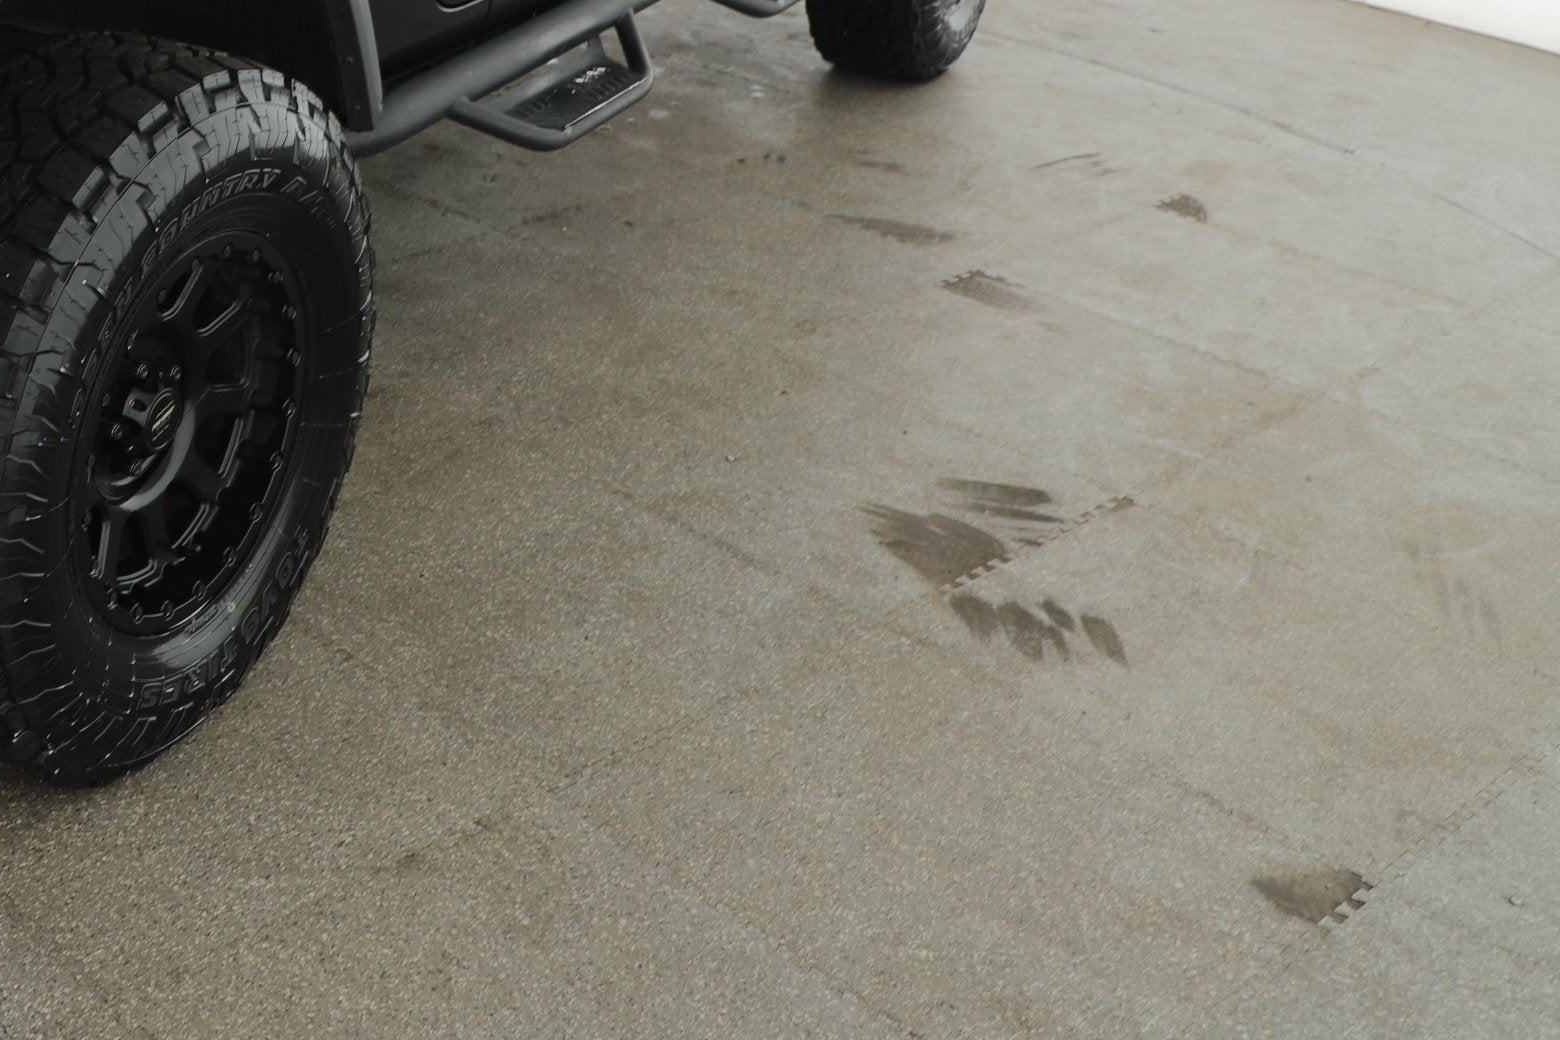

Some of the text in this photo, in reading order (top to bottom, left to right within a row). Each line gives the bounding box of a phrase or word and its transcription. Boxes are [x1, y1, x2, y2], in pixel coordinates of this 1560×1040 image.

[142, 167, 282, 280] COUNTRY
[137, 524, 308, 711] TOYO TIRES
